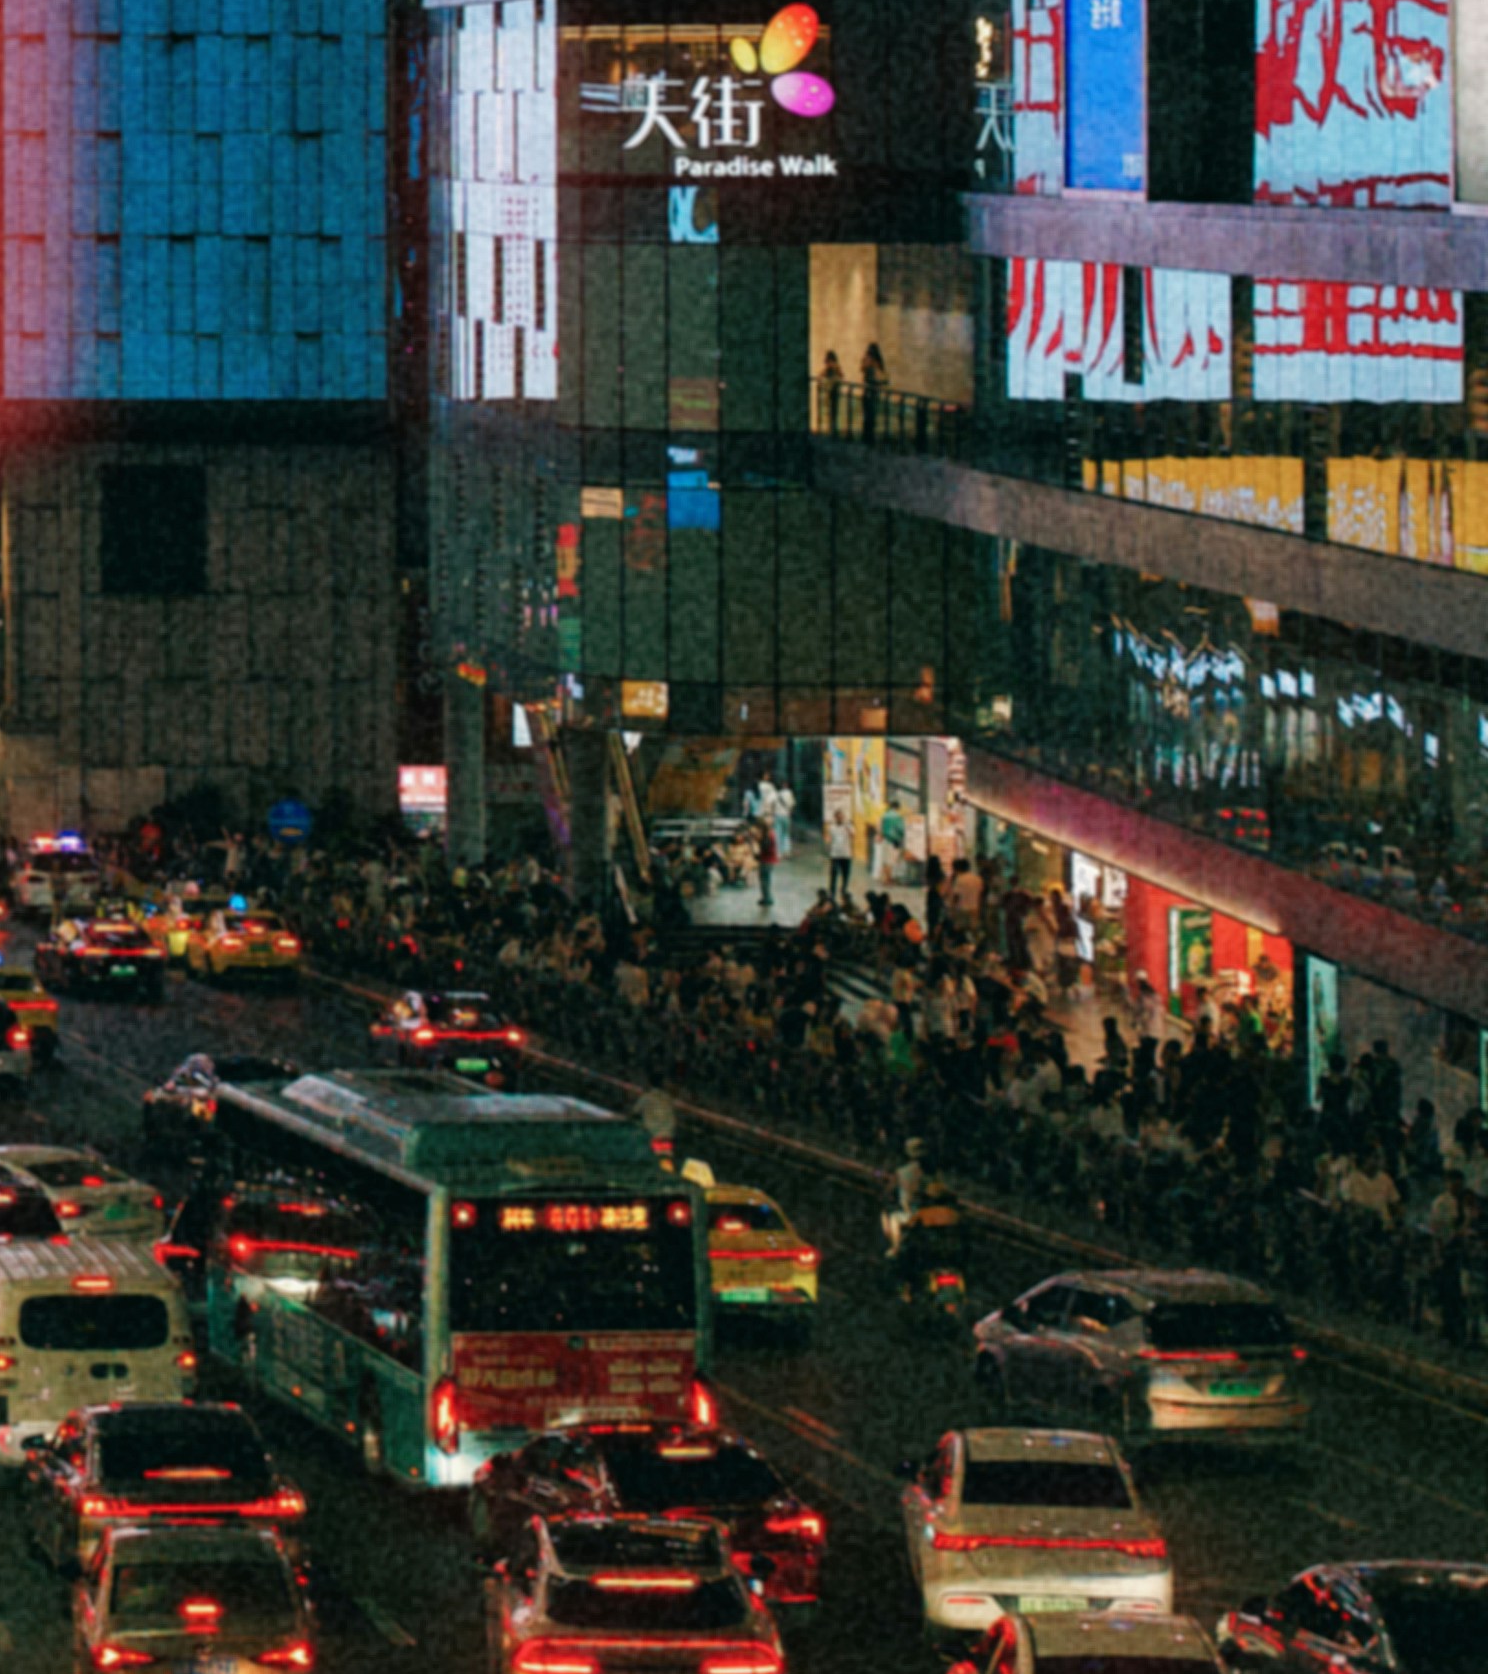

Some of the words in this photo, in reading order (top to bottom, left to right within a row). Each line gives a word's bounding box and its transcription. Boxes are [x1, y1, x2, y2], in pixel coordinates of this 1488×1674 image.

[622, 75, 765, 150] 天街
[675, 154, 774, 178] Paradise
[778, 152, 837, 178] Walk
